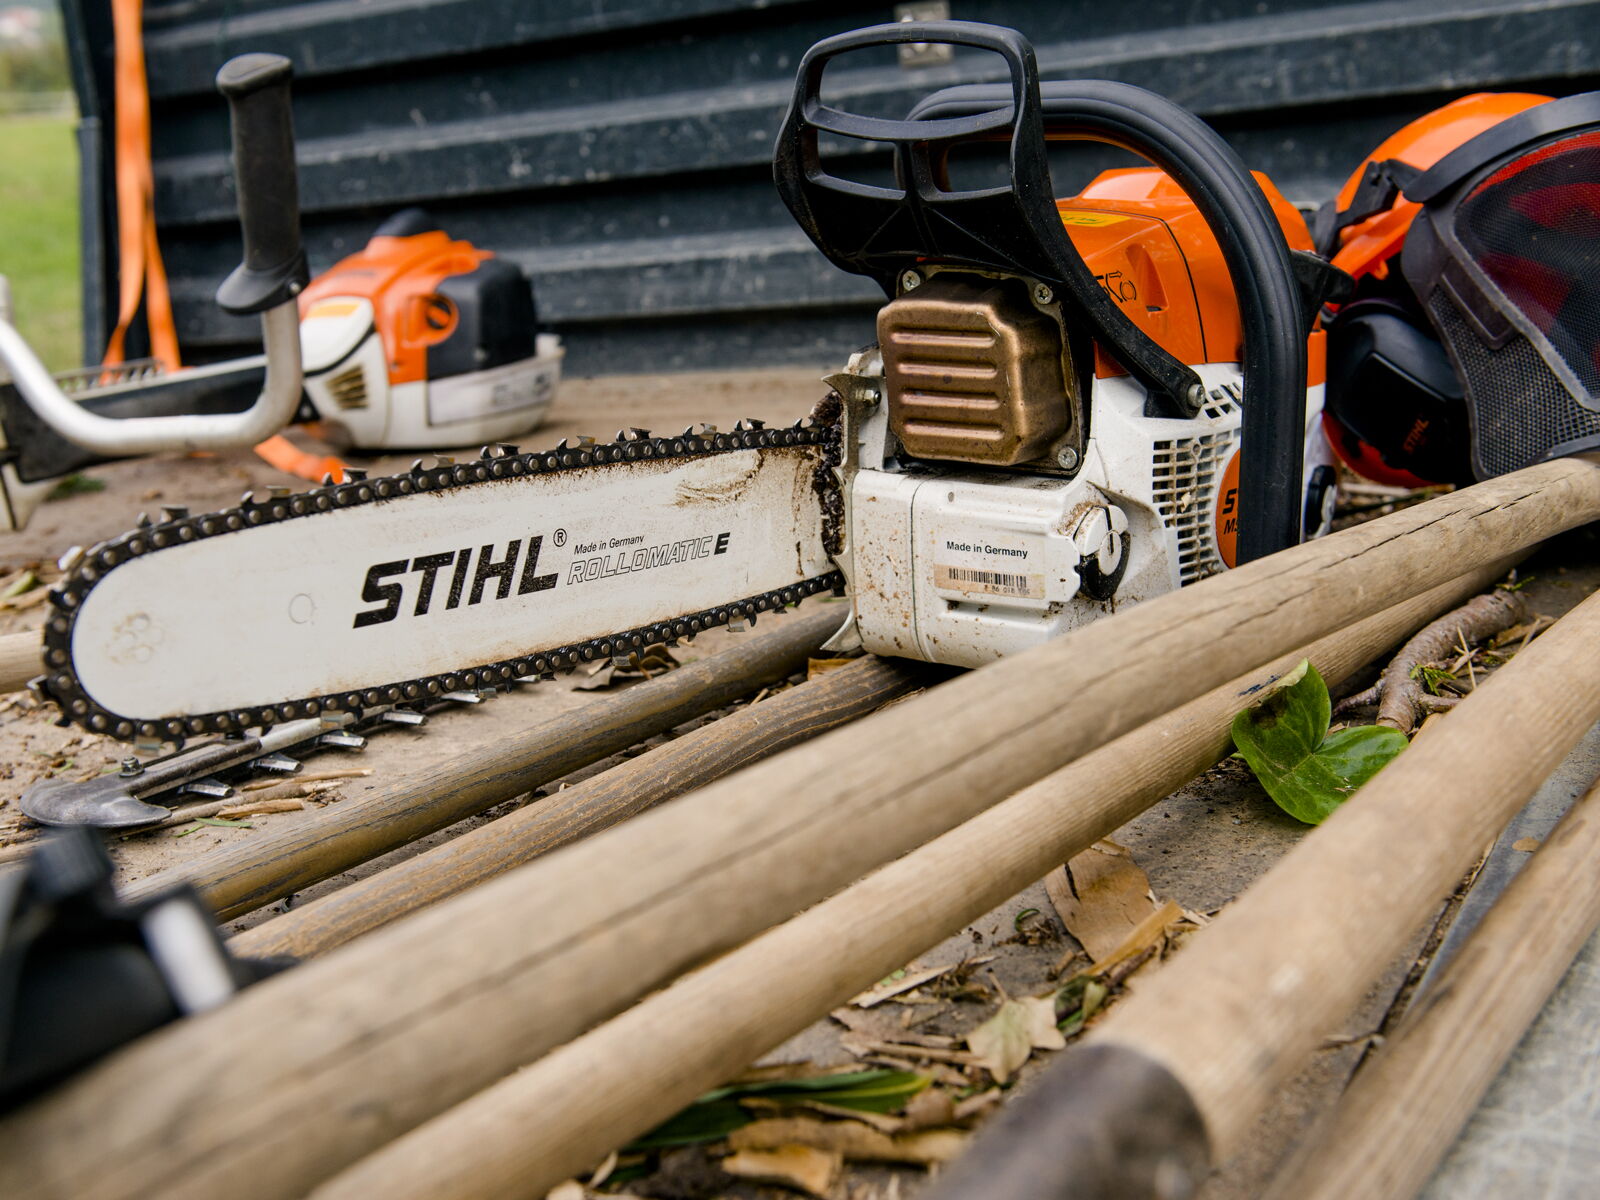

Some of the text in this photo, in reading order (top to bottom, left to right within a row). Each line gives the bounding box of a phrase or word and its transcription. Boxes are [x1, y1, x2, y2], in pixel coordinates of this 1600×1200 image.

[574, 535, 645, 555] Made in Germany
[946, 541, 1029, 560] Made in Germany
[568, 532, 731, 586] ROLLOMATIC E
